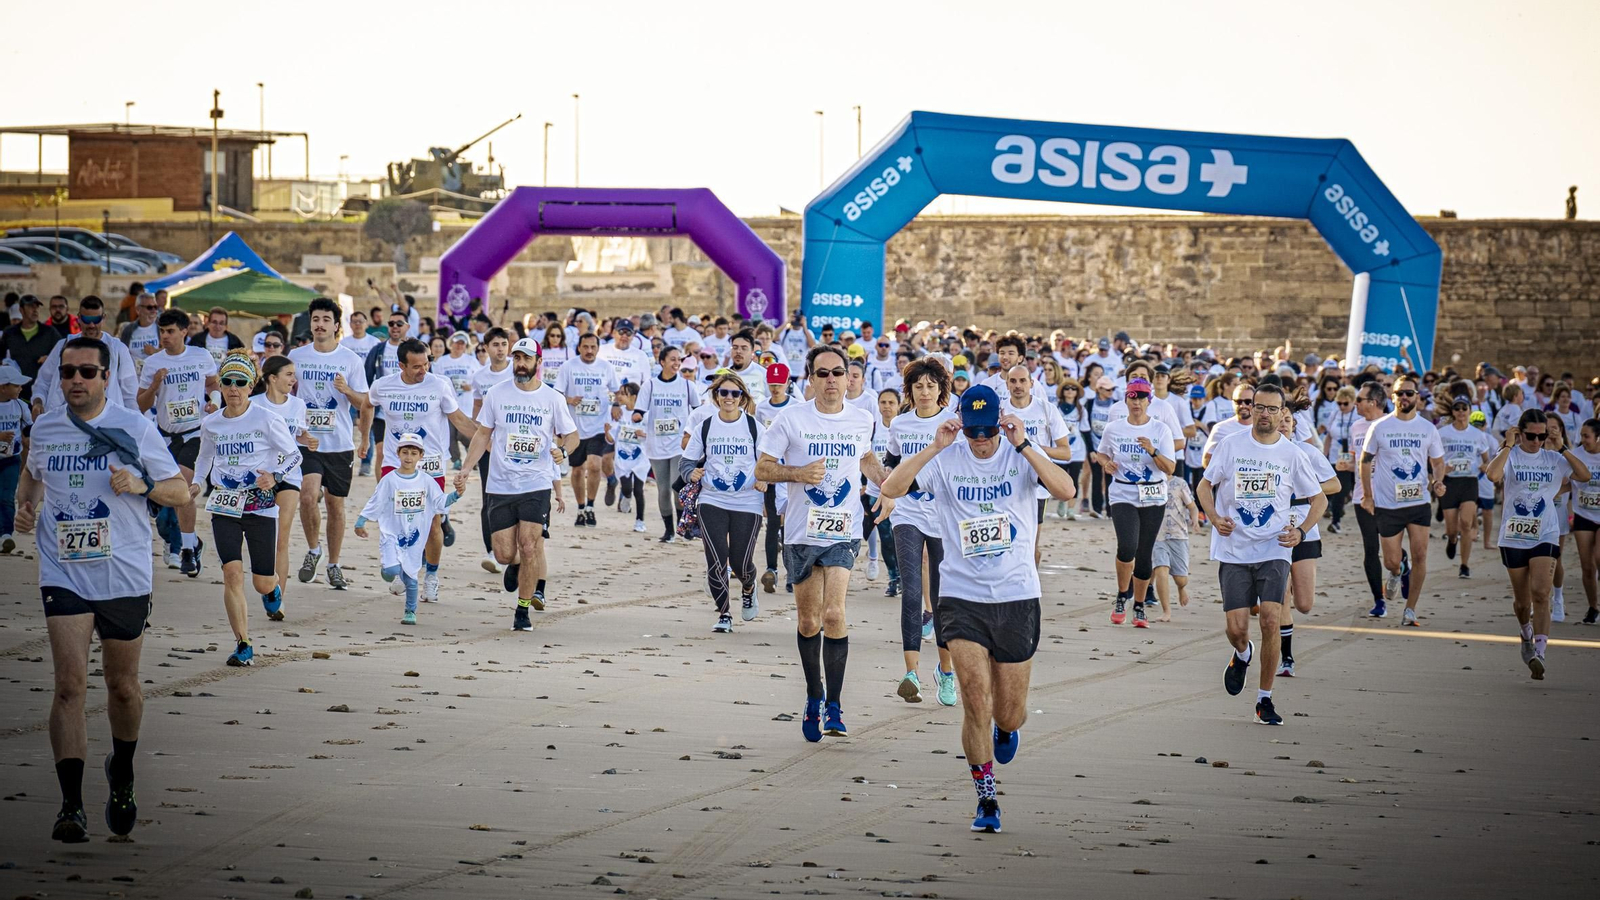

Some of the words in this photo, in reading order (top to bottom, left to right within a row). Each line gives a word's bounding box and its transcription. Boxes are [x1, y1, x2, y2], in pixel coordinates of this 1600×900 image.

[324, 362, 337, 371] favor
[575, 378, 602, 386] AUTISMO
[413, 394, 427, 402] favor
[654, 398, 682, 406] AUTISMO
[173, 406, 193, 418] 906
[389, 401, 429, 412] AUTISMO
[529, 405, 542, 414] favor
[580, 404, 596, 412] 775
[310, 415, 330, 426] 202
[505, 412, 543, 426] AUTISMO
[236, 432, 251, 440] favor
[804, 432, 828, 440] marcha
[837, 432, 853, 441] favor
[46, 442, 71, 452] marcha
[216, 441, 254, 456] AUTISMO
[513, 441, 535, 453] 666
[902, 442, 928, 454] AUTIS
[1389, 439, 1421, 448] AUTISMO
[1447, 444, 1474, 452] AUTISMO
[711, 444, 748, 455] AUTISMO
[808, 442, 856, 457] AUTISMO
[47, 455, 108, 471] AUTISMO
[422, 461, 440, 471] 409
[1236, 457, 1256, 466] marcha
[1266, 461, 1281, 471] favor
[953, 475, 979, 484] marcha
[990, 474, 1005, 484] favor
[1009, 466, 1019, 476] del
[1516, 471, 1553, 483] AUTISMO
[957, 481, 1012, 501] AUTISMO
[1243, 480, 1267, 491] 767
[1401, 488, 1419, 498] 992
[214, 494, 238, 507] 986
[401, 497, 422, 507] 665
[816, 517, 844, 532] 728
[1509, 522, 1538, 534] 1026
[66, 531, 99, 549] 276
[970, 526, 1001, 544] 882
